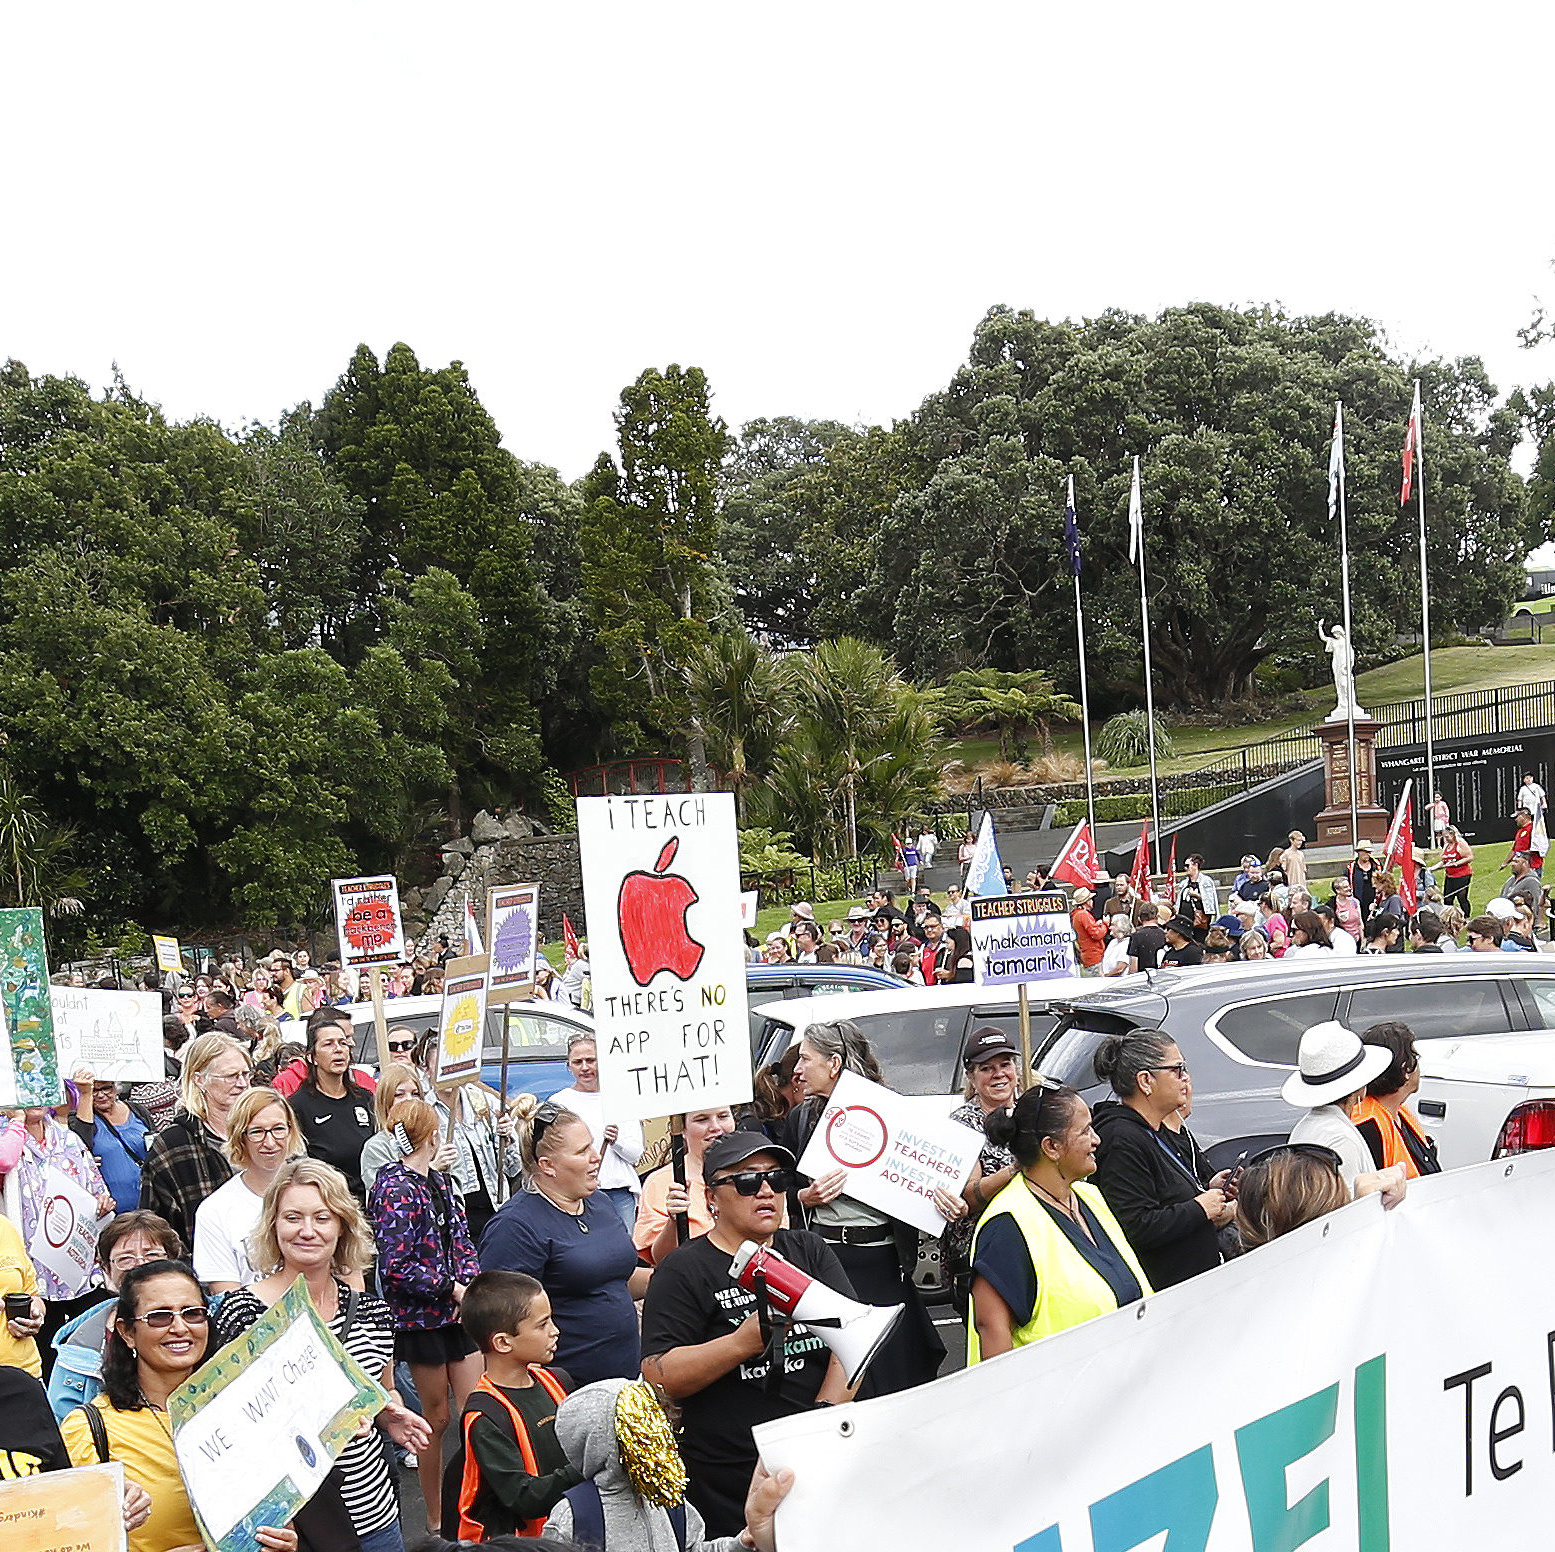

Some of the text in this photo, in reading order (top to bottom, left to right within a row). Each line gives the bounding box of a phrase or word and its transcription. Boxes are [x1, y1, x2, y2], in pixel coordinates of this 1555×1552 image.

[1461, 749, 1479, 759] WAR
[1481, 744, 1524, 756] MEMORIAL
[624, 798, 706, 829] TEACH
[352, 909, 386, 921] be a
[974, 896, 1064, 919] TEACHER STRUGGLES
[973, 927, 1071, 951] Whakamana
[985, 951, 1066, 977] tamariki
[605, 985, 726, 1017] THERE'S NO
[609, 1020, 725, 1055] APP FOR
[627, 1054, 720, 1096] THAT!
[894, 1141, 962, 1180] TEACHERS
[897, 1129, 948, 1159] INVEST
[947, 1153, 964, 1167] IN
[879, 1169, 935, 1200] AOTEAR
[885, 1156, 936, 1186] INVEST
[739, 1357, 806, 1381] kaiko
[198, 1427, 233, 1463] WE
[242, 1376, 280, 1424] WANT
[1442, 1360, 1526, 1497] Te
[76, 1542, 91, 1552] We
